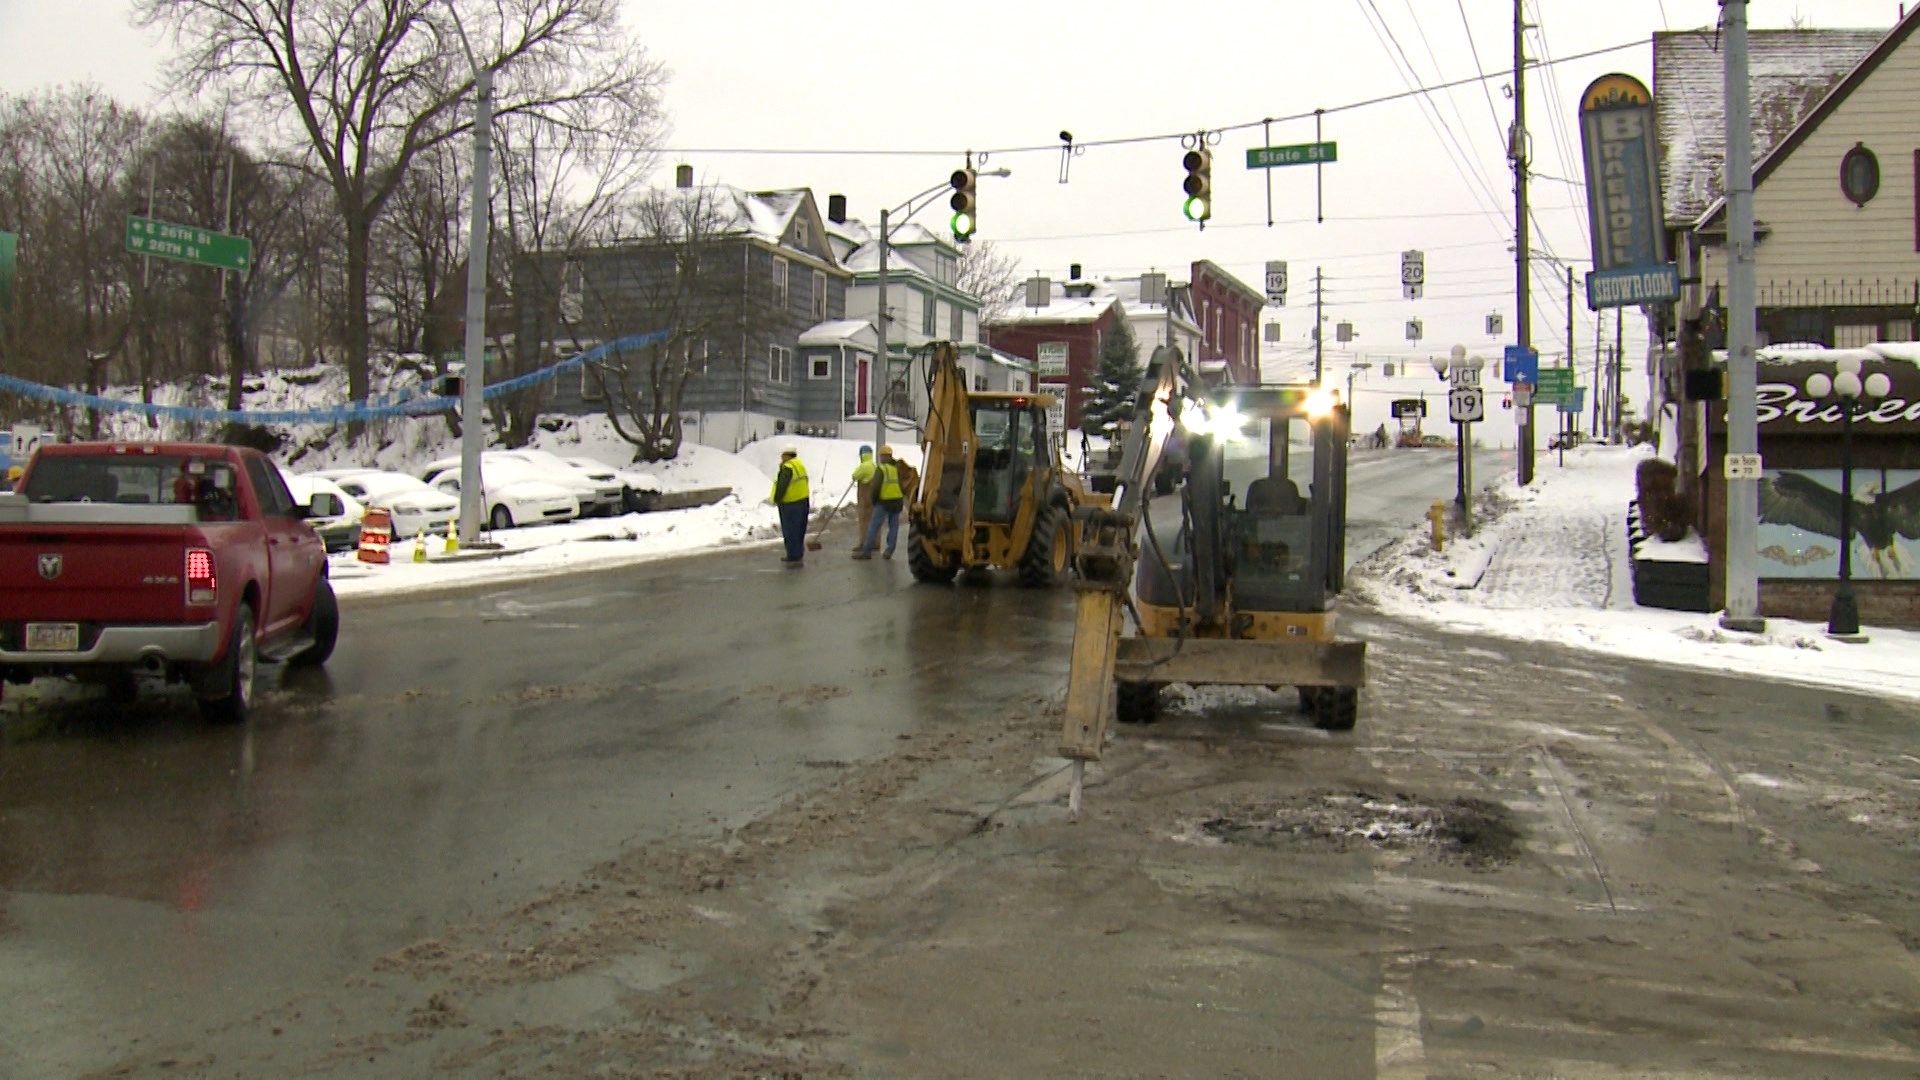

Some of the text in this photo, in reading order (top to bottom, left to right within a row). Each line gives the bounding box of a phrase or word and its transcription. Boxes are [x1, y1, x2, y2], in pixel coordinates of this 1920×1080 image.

[1258, 147, 1325, 164] State St
[146, 223, 154, 234] E
[131, 235, 144, 248] W
[148, 239, 181, 254] 26TH
[1404, 267, 1421, 279] 20
[1270, 275, 1283, 288] 19
[1594, 272, 1674, 303] SHOWROOM
[1453, 369, 1476, 384] JCT
[1456, 395, 1475, 414] 19
